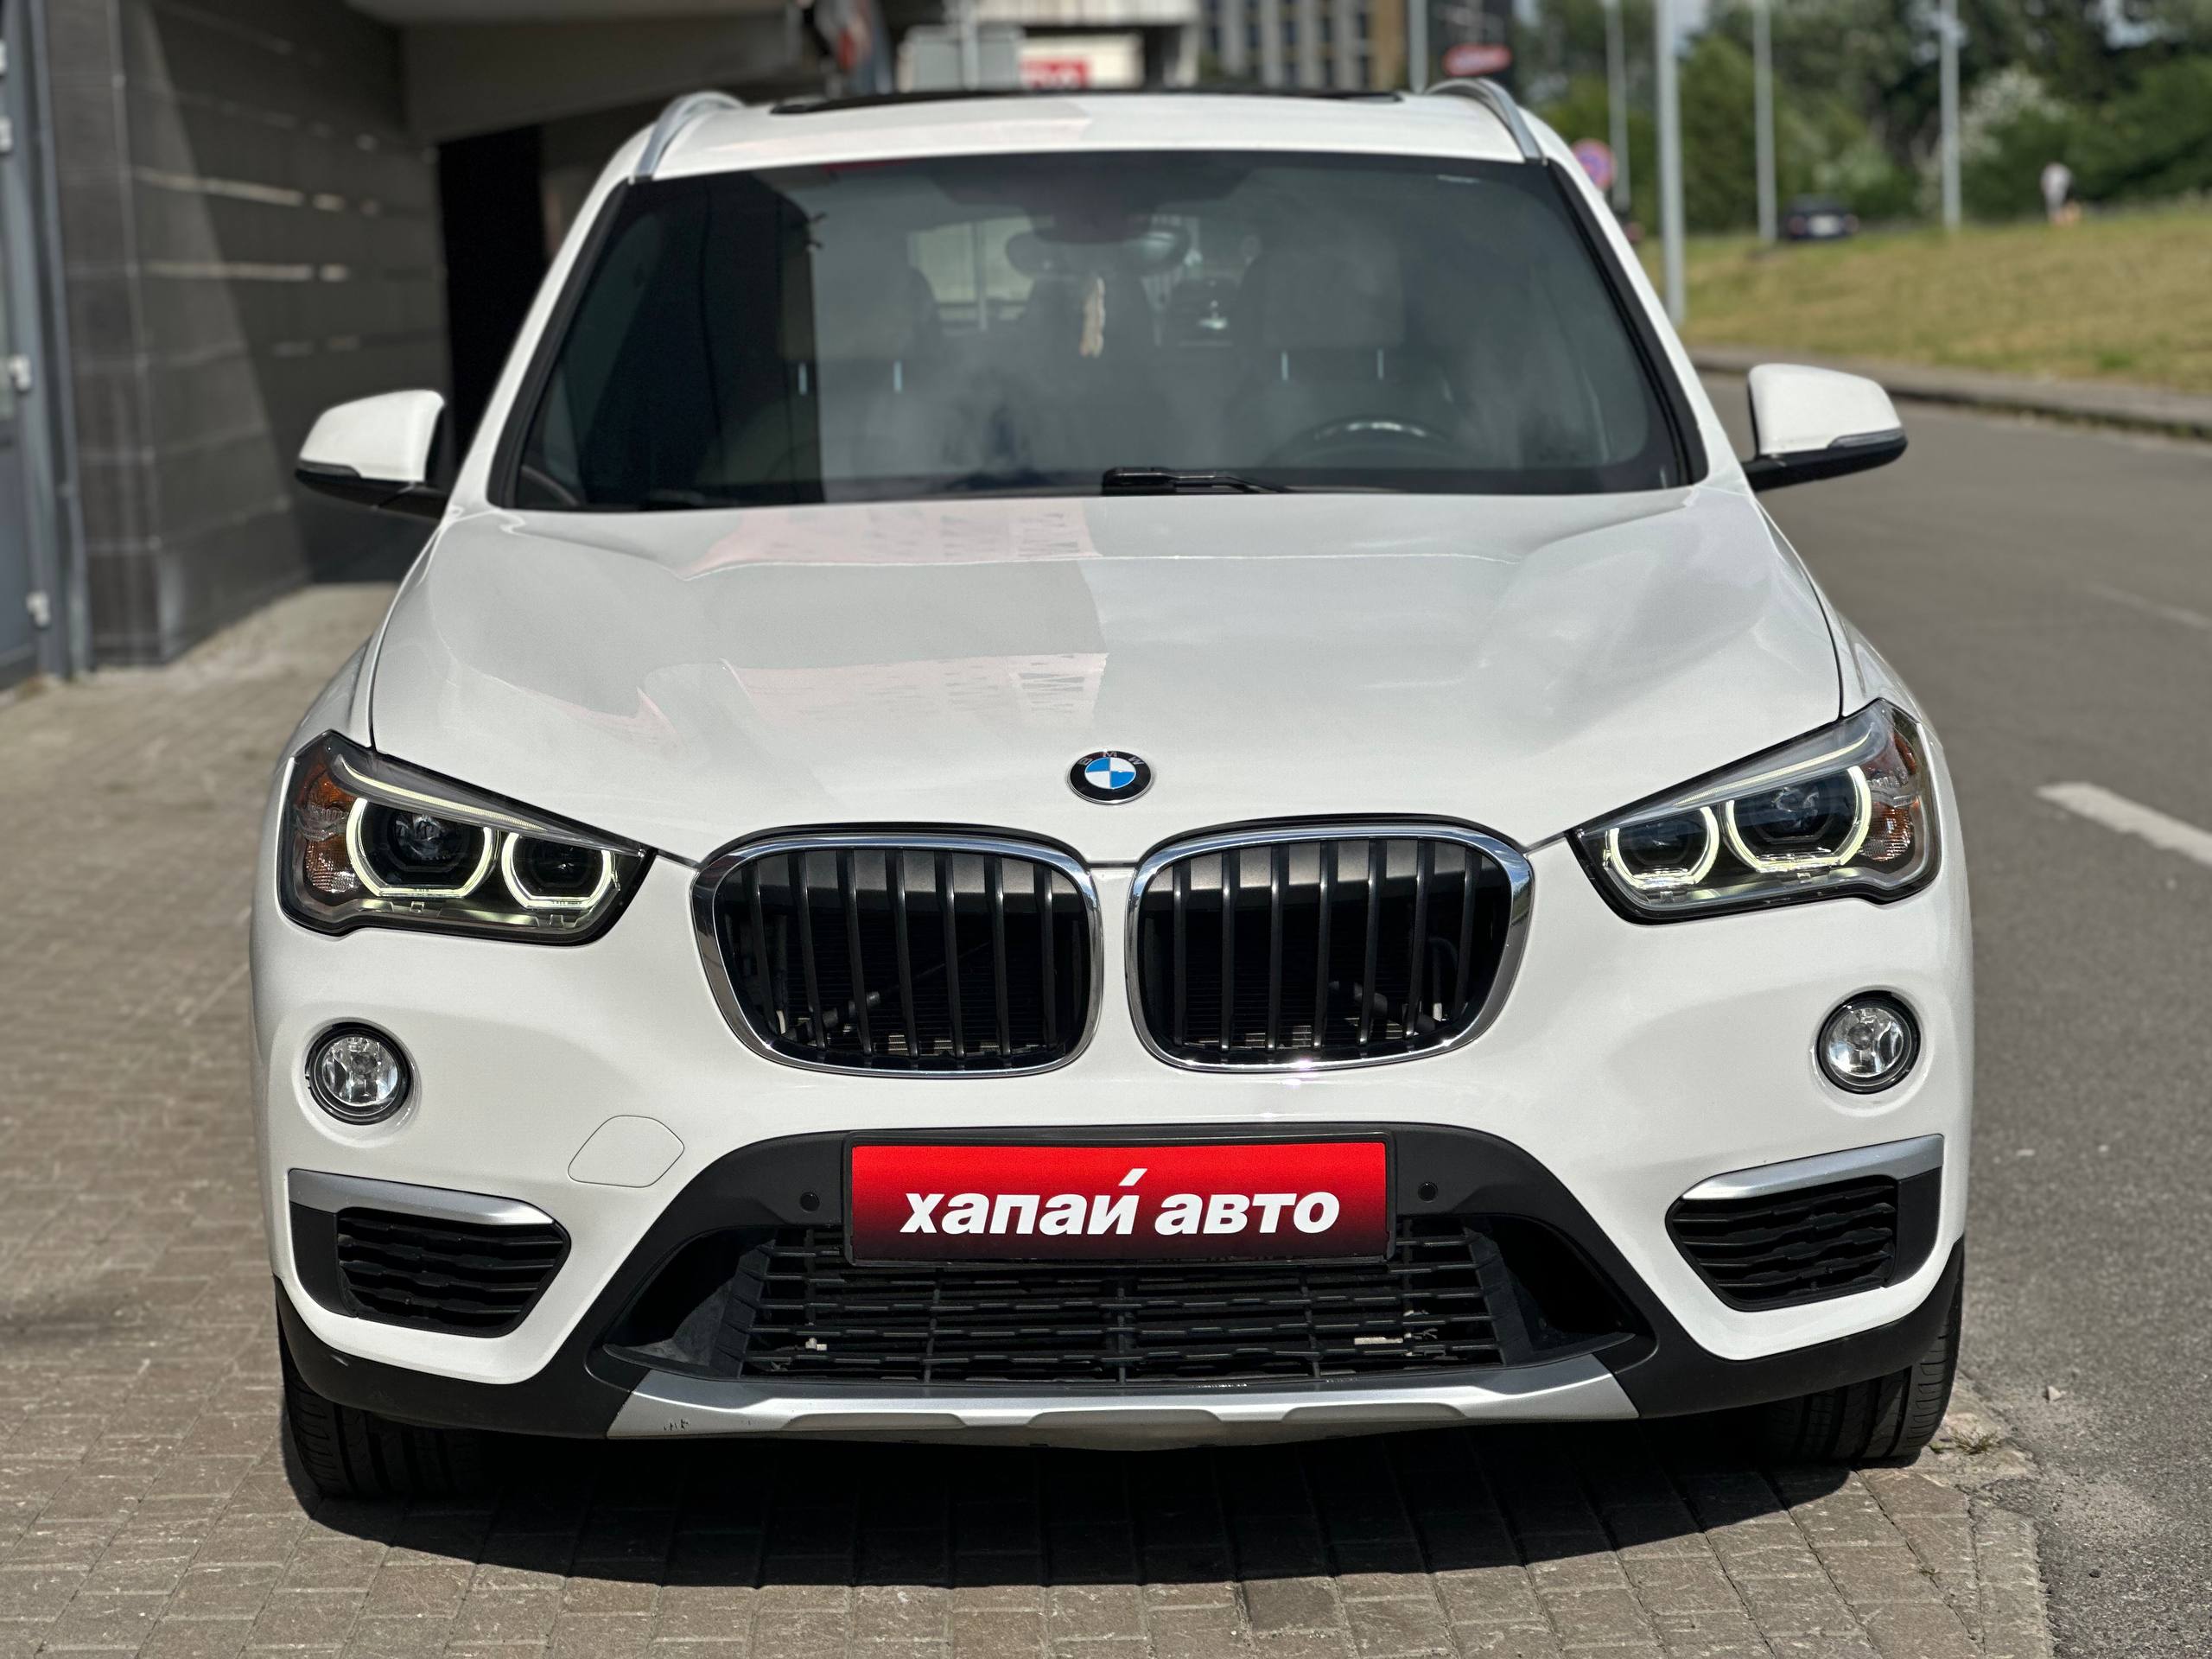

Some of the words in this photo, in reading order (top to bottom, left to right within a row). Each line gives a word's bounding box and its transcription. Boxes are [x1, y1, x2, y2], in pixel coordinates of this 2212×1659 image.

[1077, 751, 1144, 766] BMW
[899, 1167, 1148, 1236] хапай
[1154, 1192, 1340, 1236] авто
